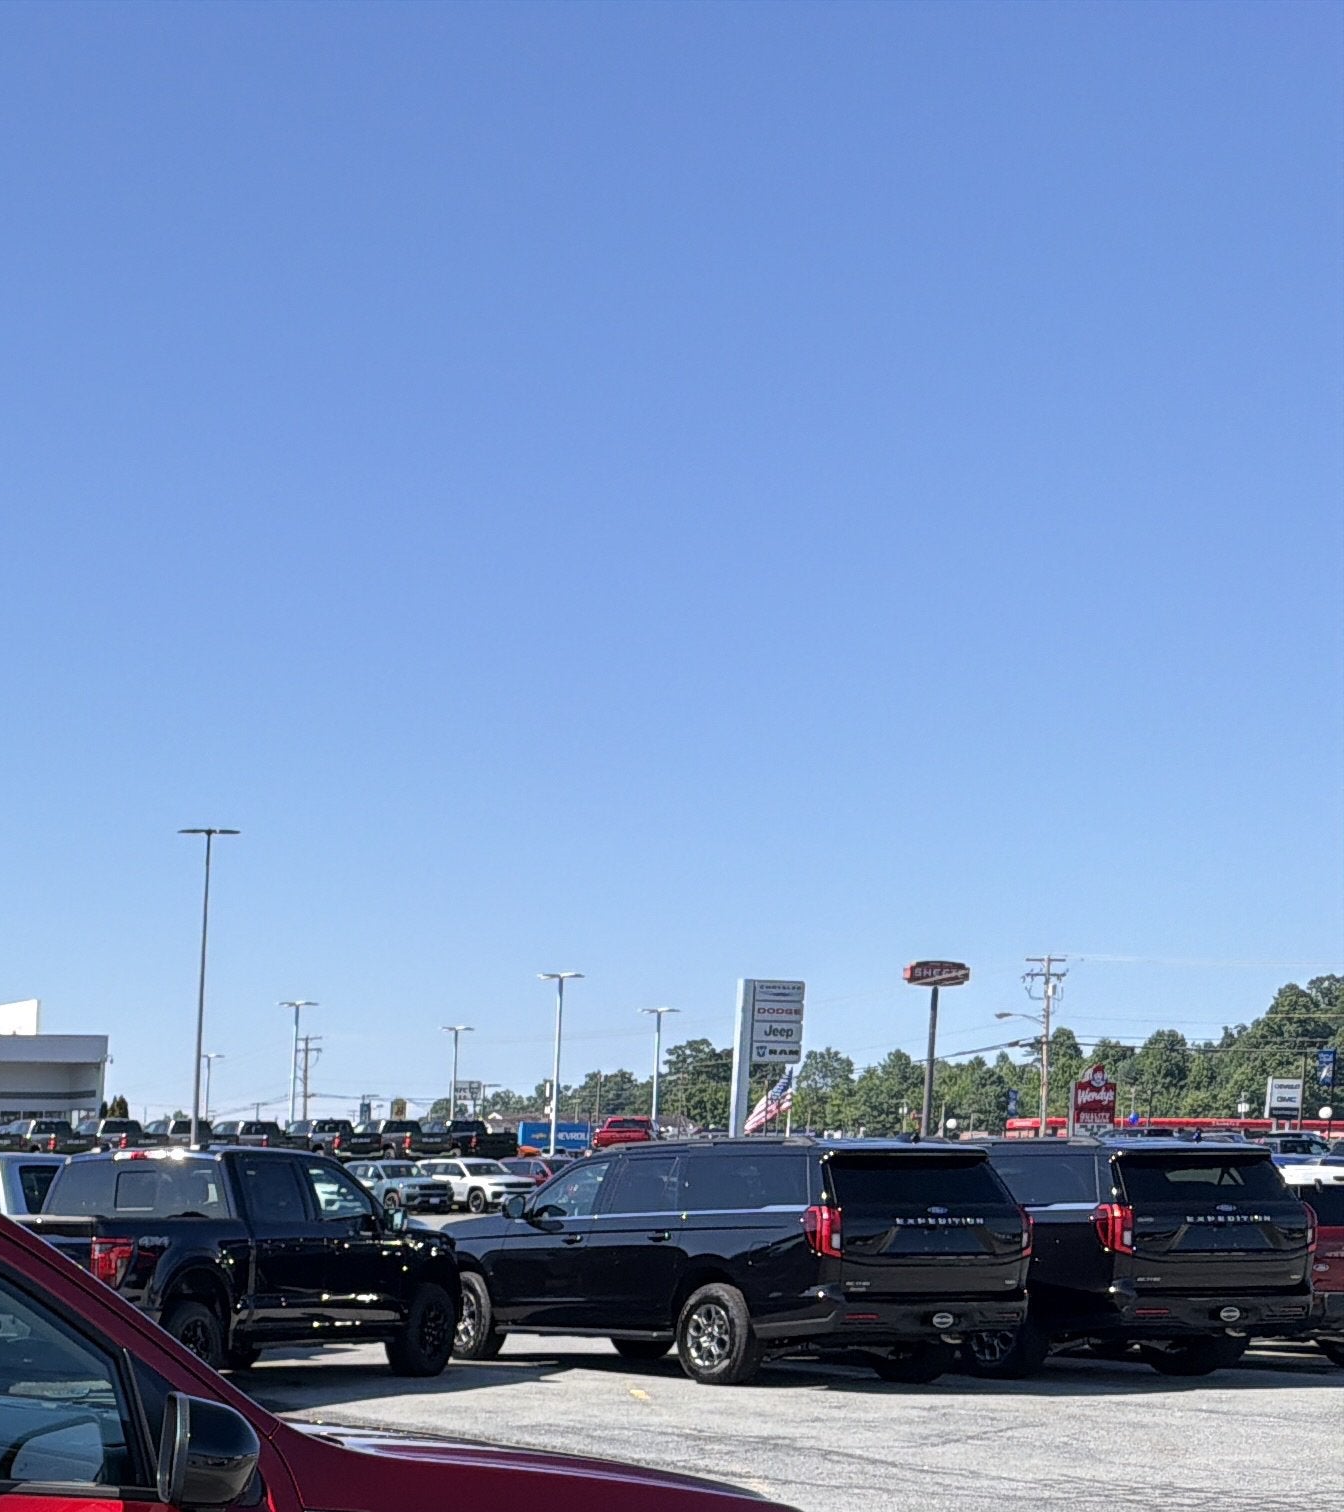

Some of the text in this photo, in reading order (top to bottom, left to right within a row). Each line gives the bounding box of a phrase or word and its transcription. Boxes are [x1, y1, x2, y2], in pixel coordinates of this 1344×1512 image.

[757, 1007, 801, 1015] DODGE
[764, 1024, 794, 1039] Jeep
[768, 1048, 800, 1056] RAM
[1077, 1087, 1114, 1105] Wendy's
[895, 1217, 984, 1225] EXPEDITION
[1186, 1215, 1271, 1223] EXPEDITION
